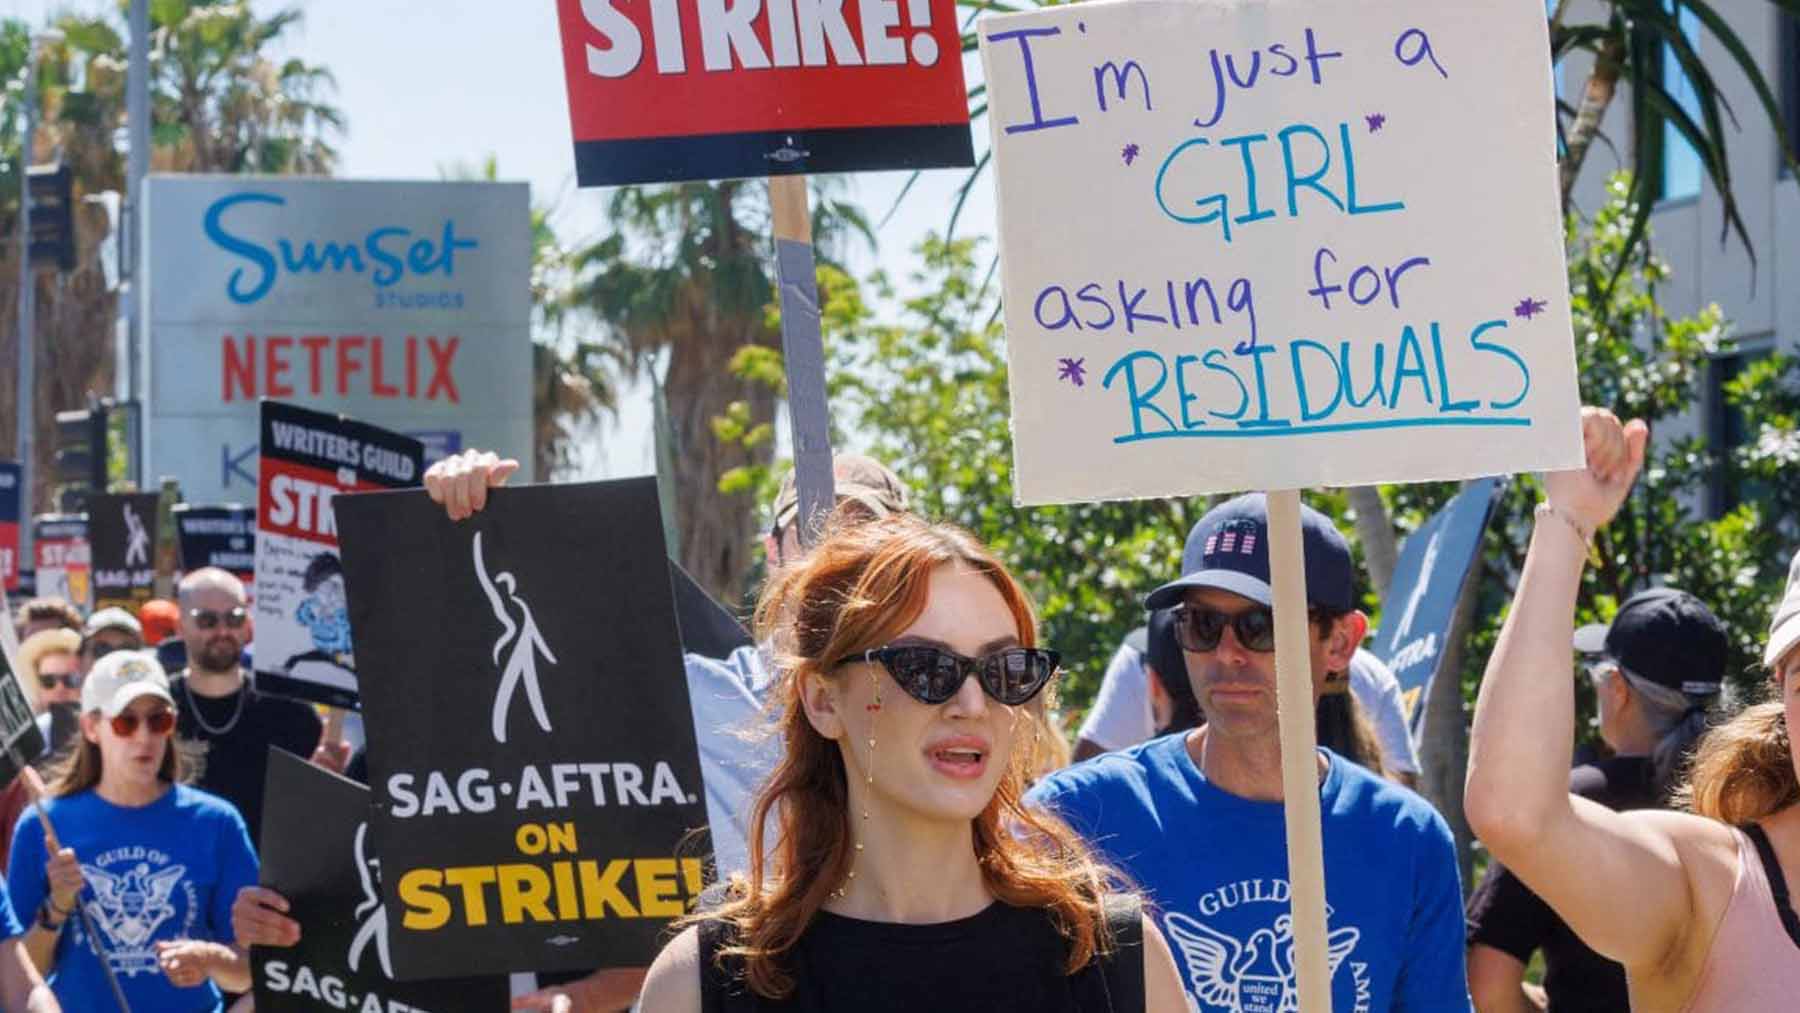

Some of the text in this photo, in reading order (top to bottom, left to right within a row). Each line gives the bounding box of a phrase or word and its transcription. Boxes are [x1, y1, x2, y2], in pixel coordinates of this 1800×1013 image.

[581, 0, 940, 79] STRIKE!
[987, 20, 1448, 135] I'm just a
[1154, 122, 1406, 242] GIRL
[204, 191, 478, 305] Sunset
[375, 292, 465, 309] STUDIOS
[1033, 247, 1430, 355] asking for
[222, 334, 461, 404] NETFLIX
[1102, 320, 1532, 438] RESIDUALS
[272, 420, 361, 466] WRITERS
[363, 444, 415, 481] GUILD
[96, 846, 146, 867] GUILD
[515, 822, 580, 856] ON
[397, 857, 702, 931] STRIKE!
[1199, 879, 1293, 917] GUILD
[1242, 982, 1279, 996] united
